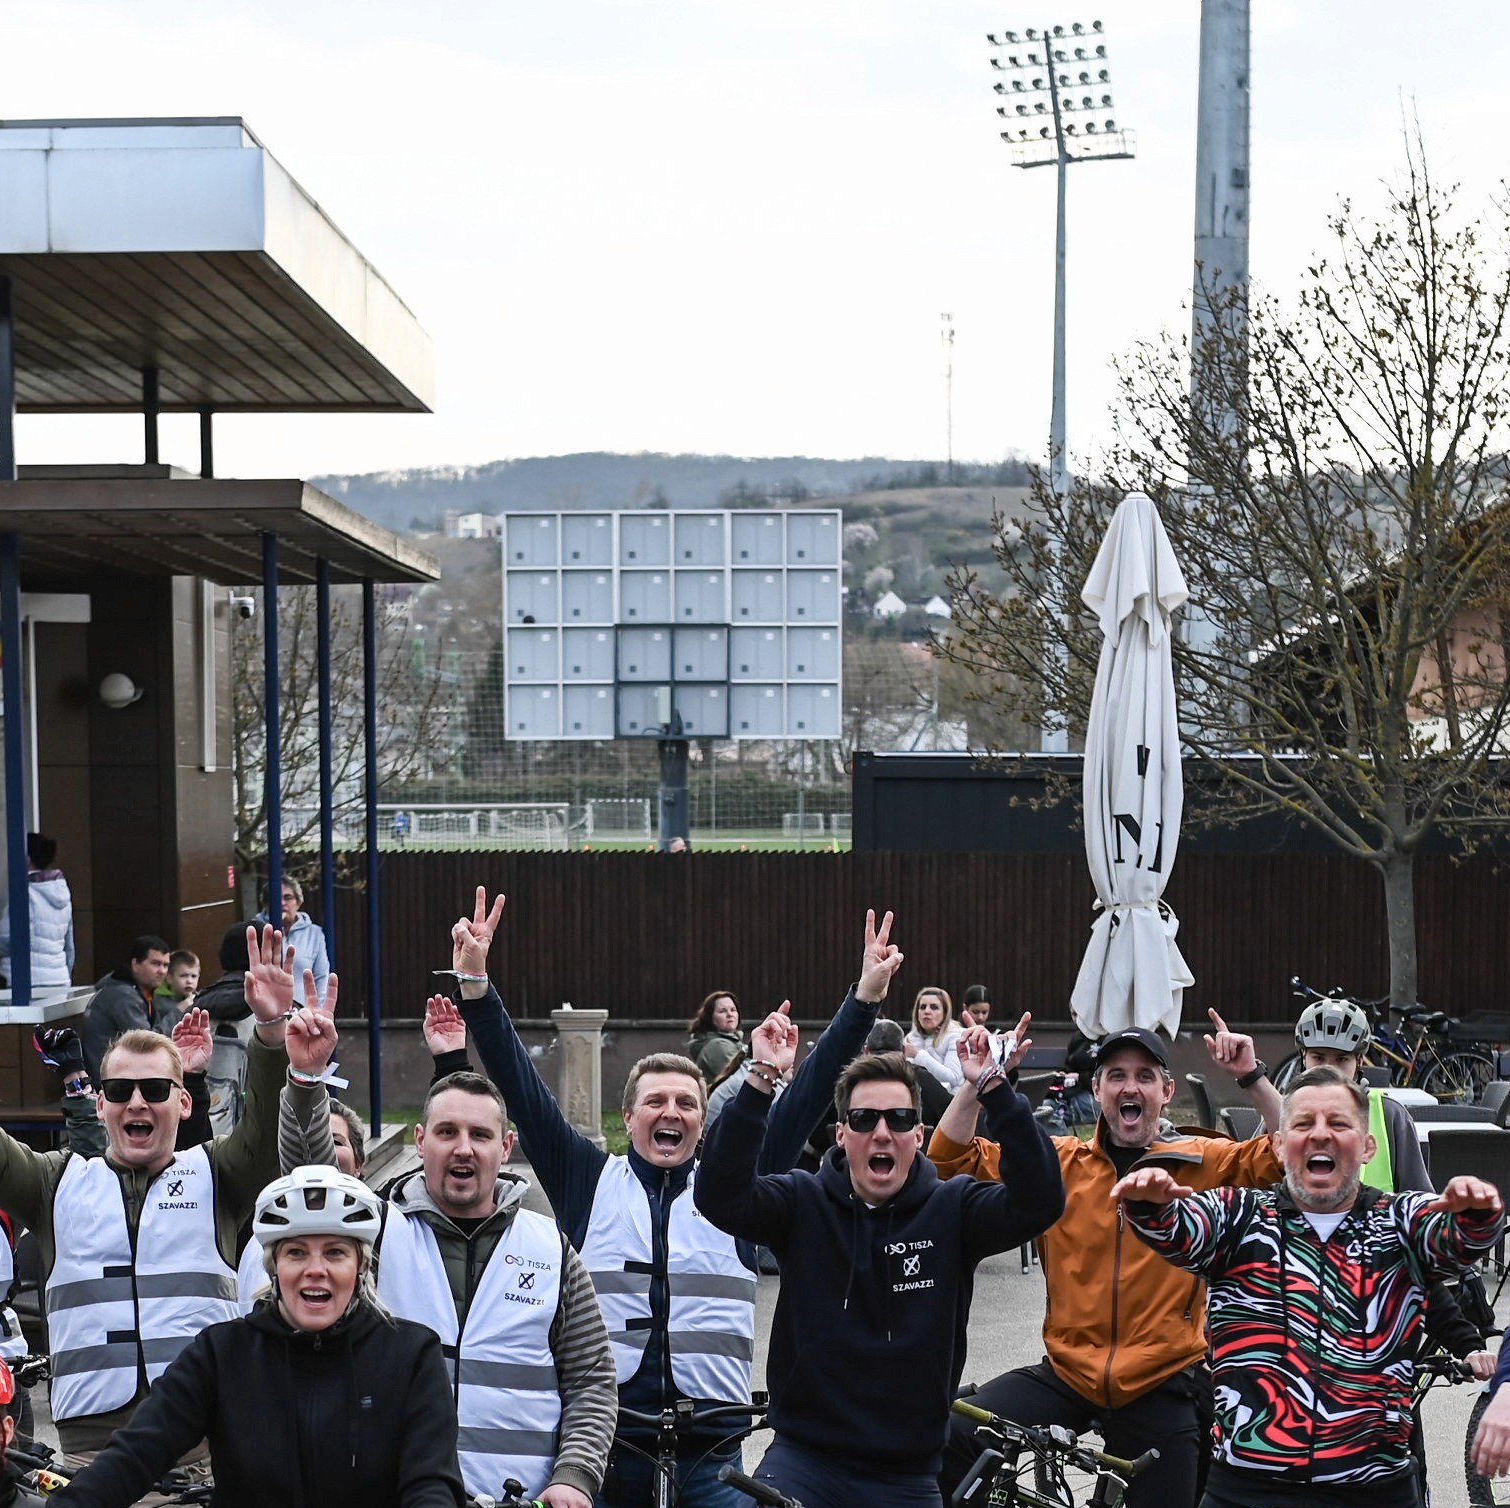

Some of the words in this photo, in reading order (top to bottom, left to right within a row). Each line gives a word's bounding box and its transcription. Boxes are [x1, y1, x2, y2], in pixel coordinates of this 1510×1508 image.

[158, 1202, 198, 1210] SZAVAZZ!
[909, 1239, 934, 1251] TISZA
[527, 1260, 552, 1271] TISZA
[893, 1279, 934, 1292] SZAVAZZ!
[504, 1292, 545, 1306] SZAVAZZ!
